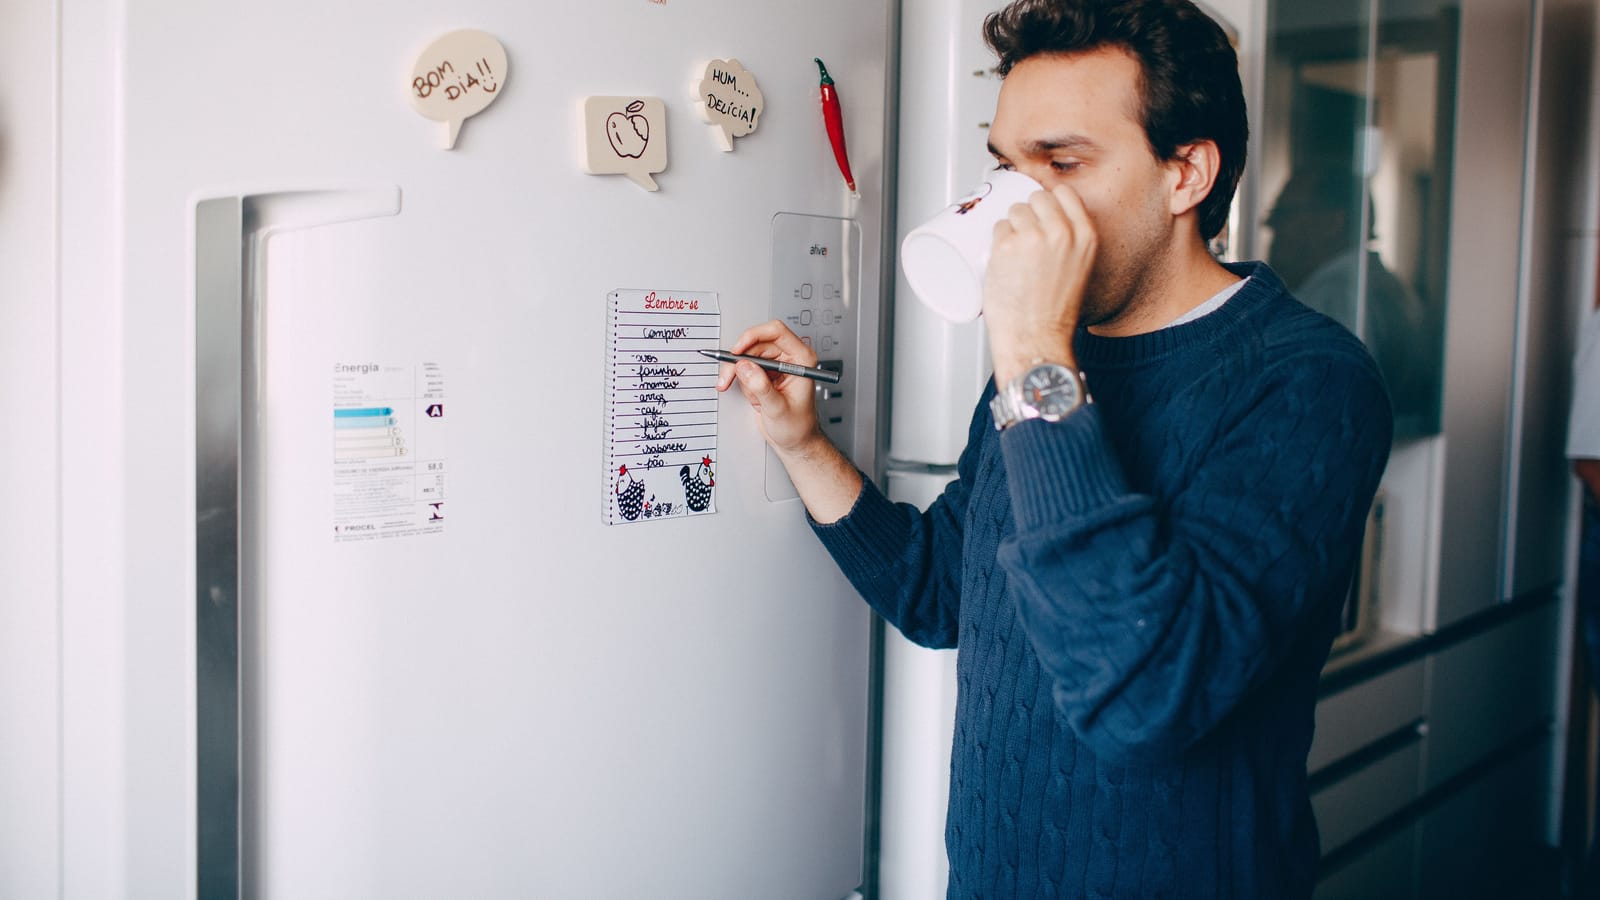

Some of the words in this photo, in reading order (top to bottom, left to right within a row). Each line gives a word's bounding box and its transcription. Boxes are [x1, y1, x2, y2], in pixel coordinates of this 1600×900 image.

[413, 60, 454, 98] BOM
[712, 68, 749, 97] HUM...
[707, 93, 756, 129] DELÍCIA!
[645, 291, 699, 310] Lembre-se
[430, 404, 442, 417] A
